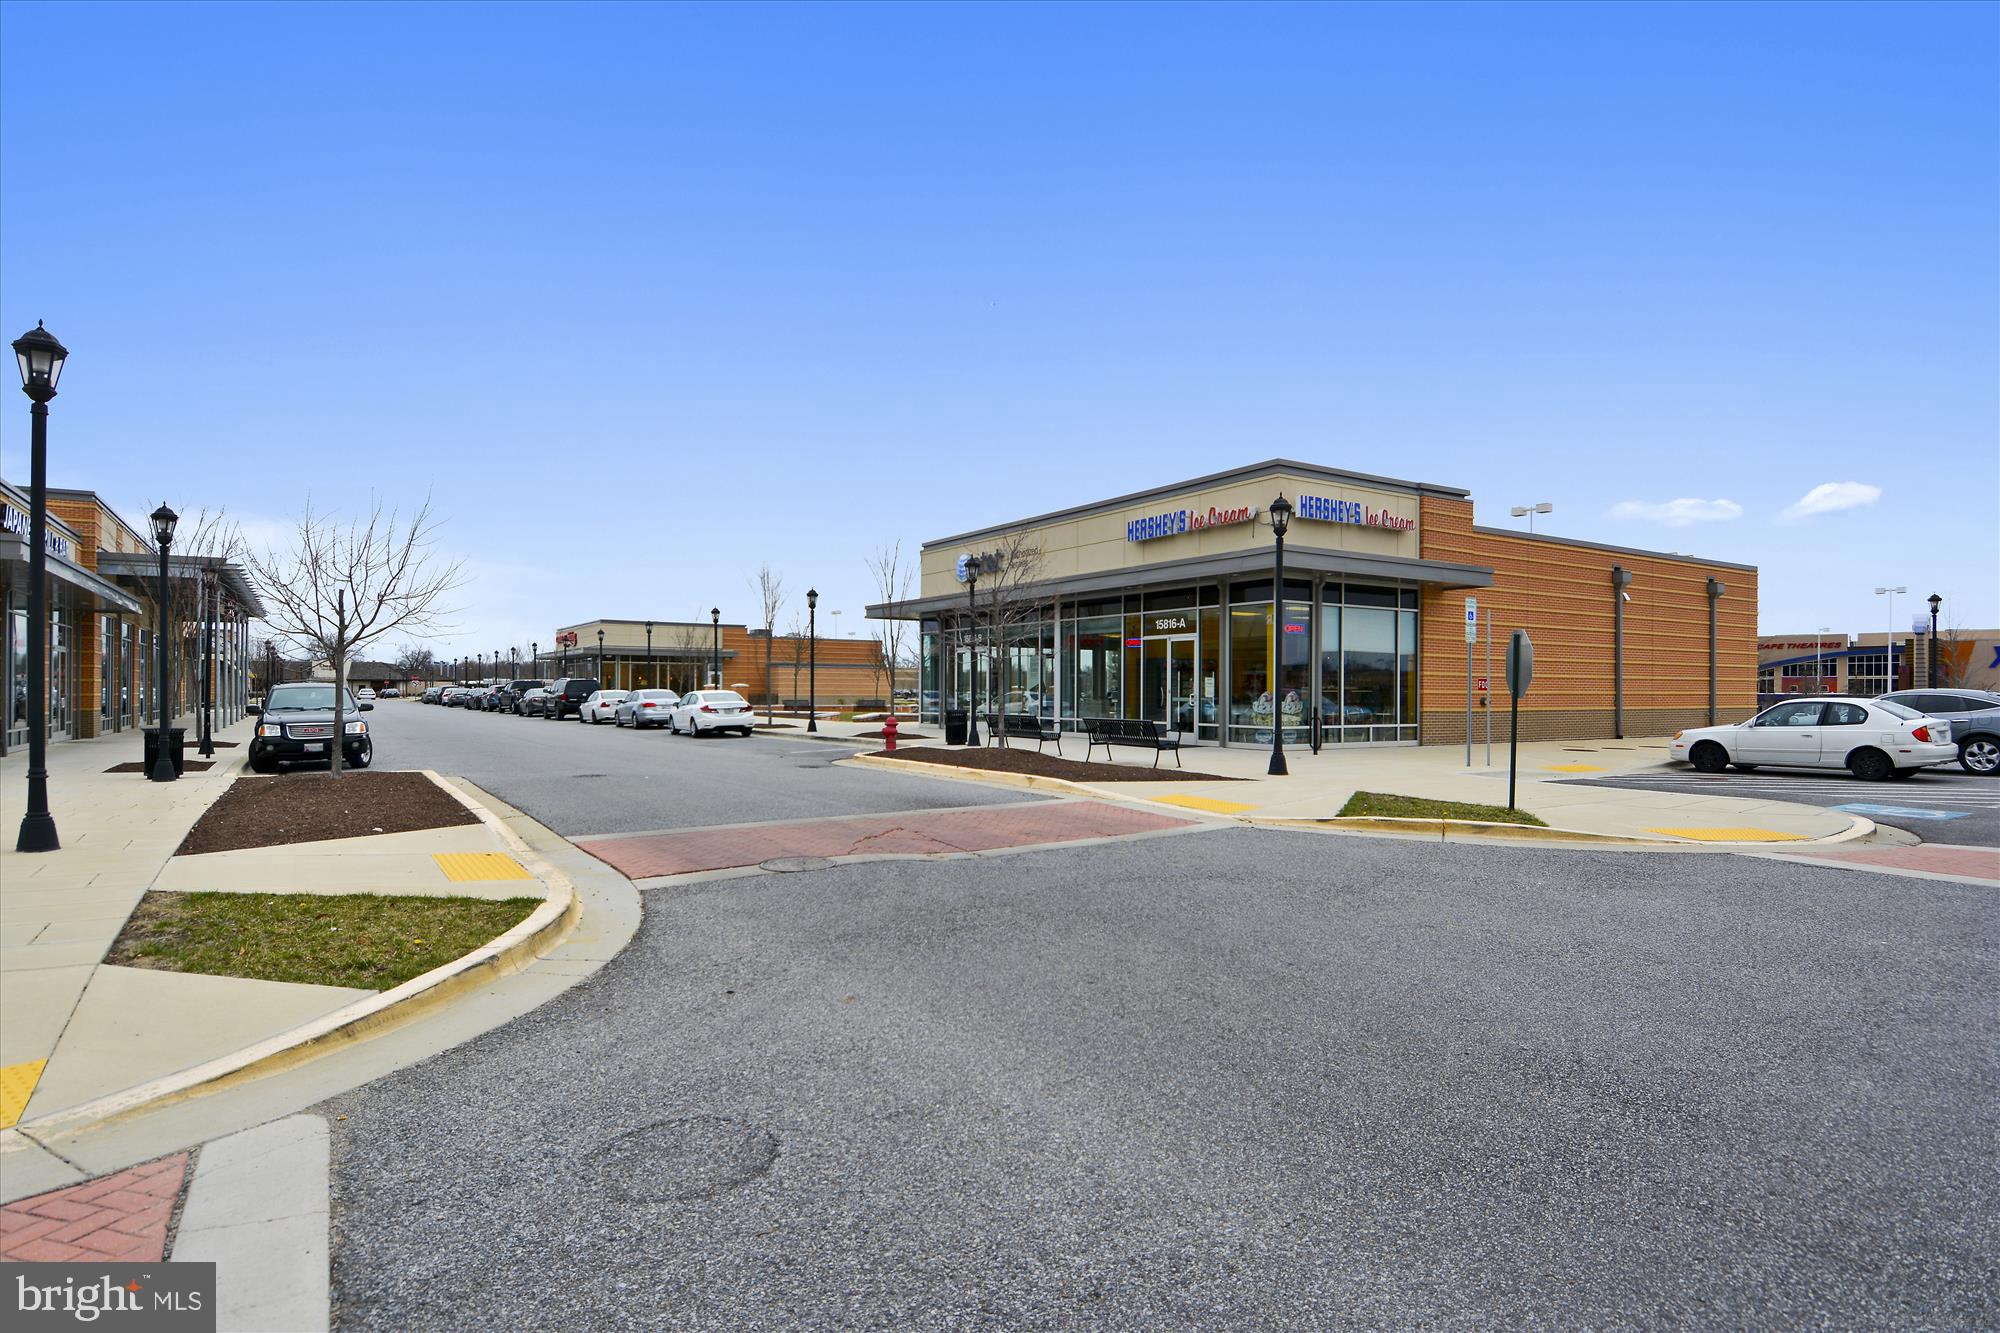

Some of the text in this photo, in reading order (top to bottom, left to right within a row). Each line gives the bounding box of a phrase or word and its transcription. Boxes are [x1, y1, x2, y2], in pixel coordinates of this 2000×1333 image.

[4, 504, 31, 537] JAPANE
[1127, 506, 1251, 541] HERSHEY'S Ice Cream
[1300, 495, 1415, 530] HERSHEY'S Ice Cream
[1155, 618, 1186, 630] 15816-A
